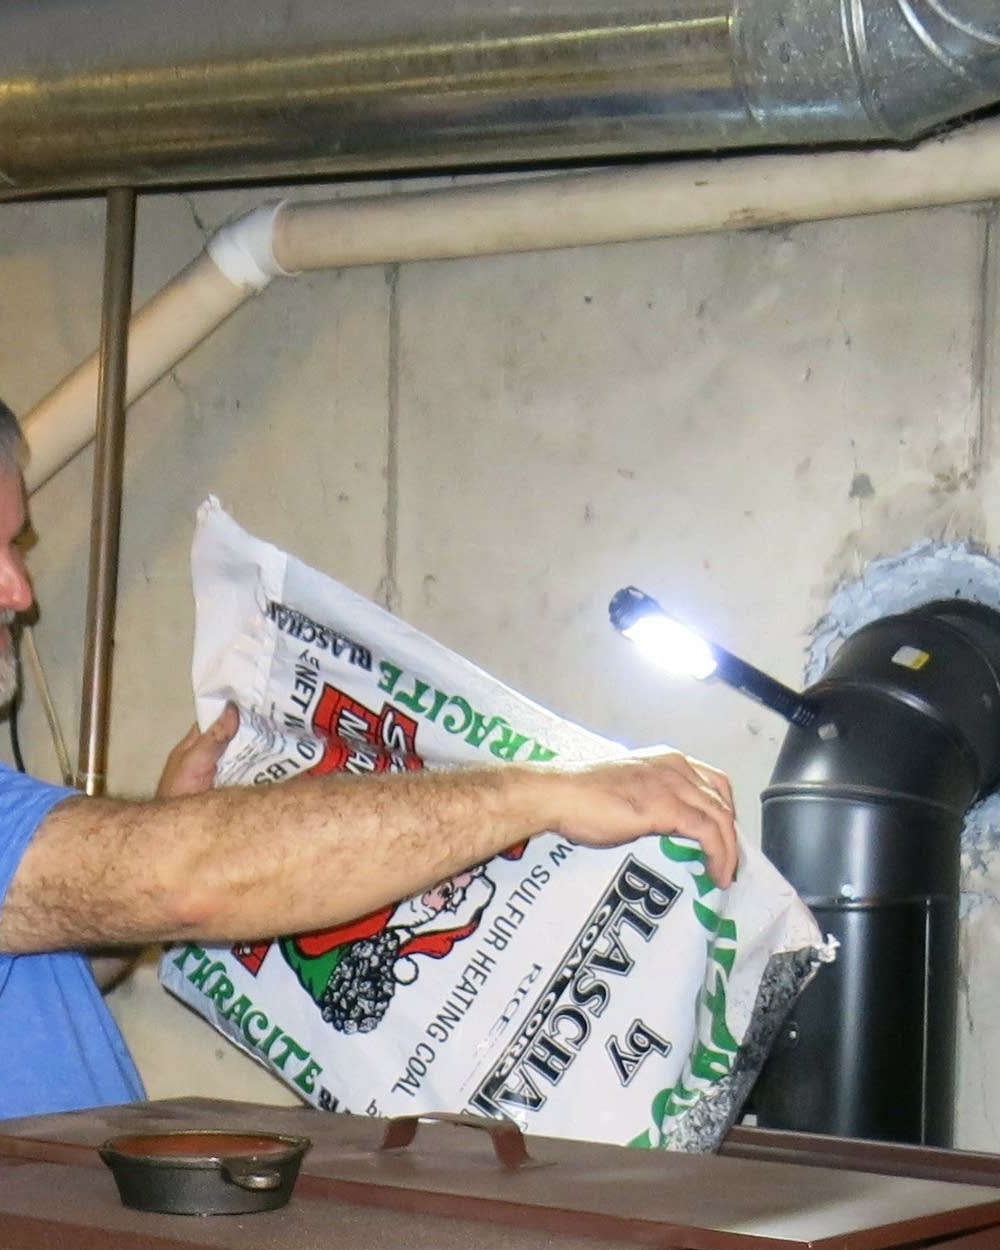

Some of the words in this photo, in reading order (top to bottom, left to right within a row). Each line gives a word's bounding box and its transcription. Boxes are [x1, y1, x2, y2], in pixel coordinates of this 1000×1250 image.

[291, 663, 319, 714] NET
[299, 649, 320, 670] by
[483, 864, 551, 951] SULFUR
[434, 947, 497, 1044] HEATING
[391, 1041, 436, 1098] COAL
[604, 1018, 673, 1088] by
